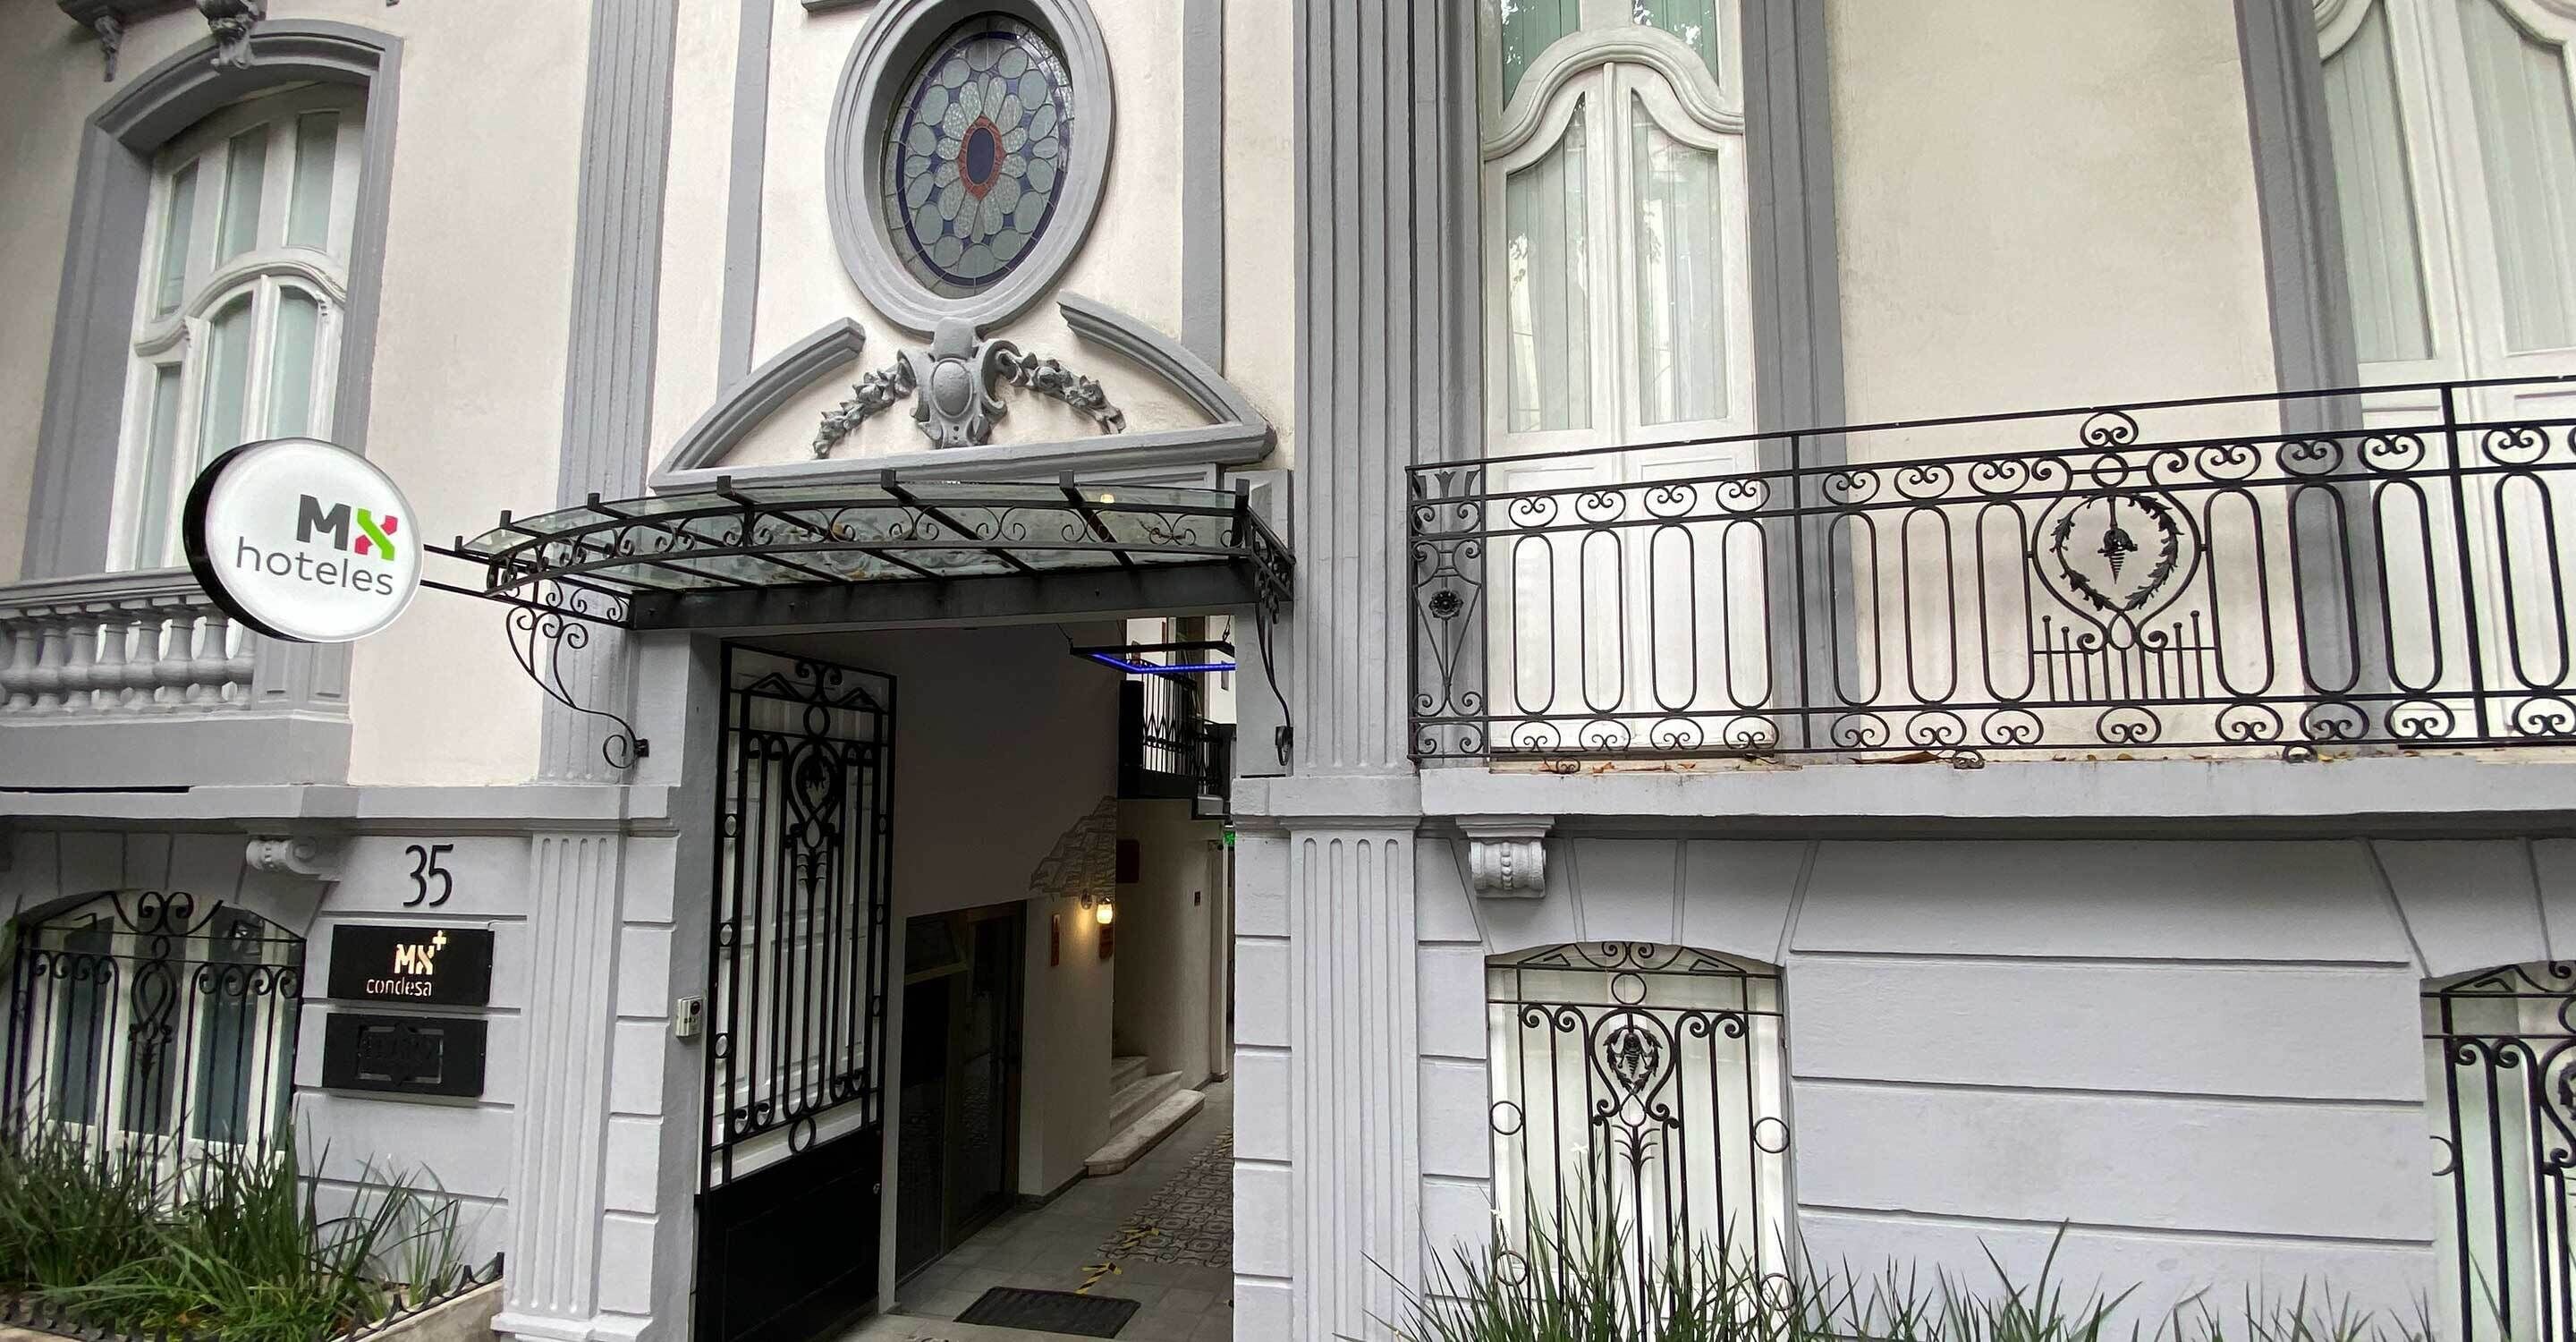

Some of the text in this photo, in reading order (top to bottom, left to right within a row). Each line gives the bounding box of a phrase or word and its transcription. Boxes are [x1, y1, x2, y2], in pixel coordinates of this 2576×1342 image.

[296, 494, 398, 562] MX
[236, 536, 394, 596] hoteles
[402, 844, 454, 907] 35
[366, 976, 432, 997] condesa
